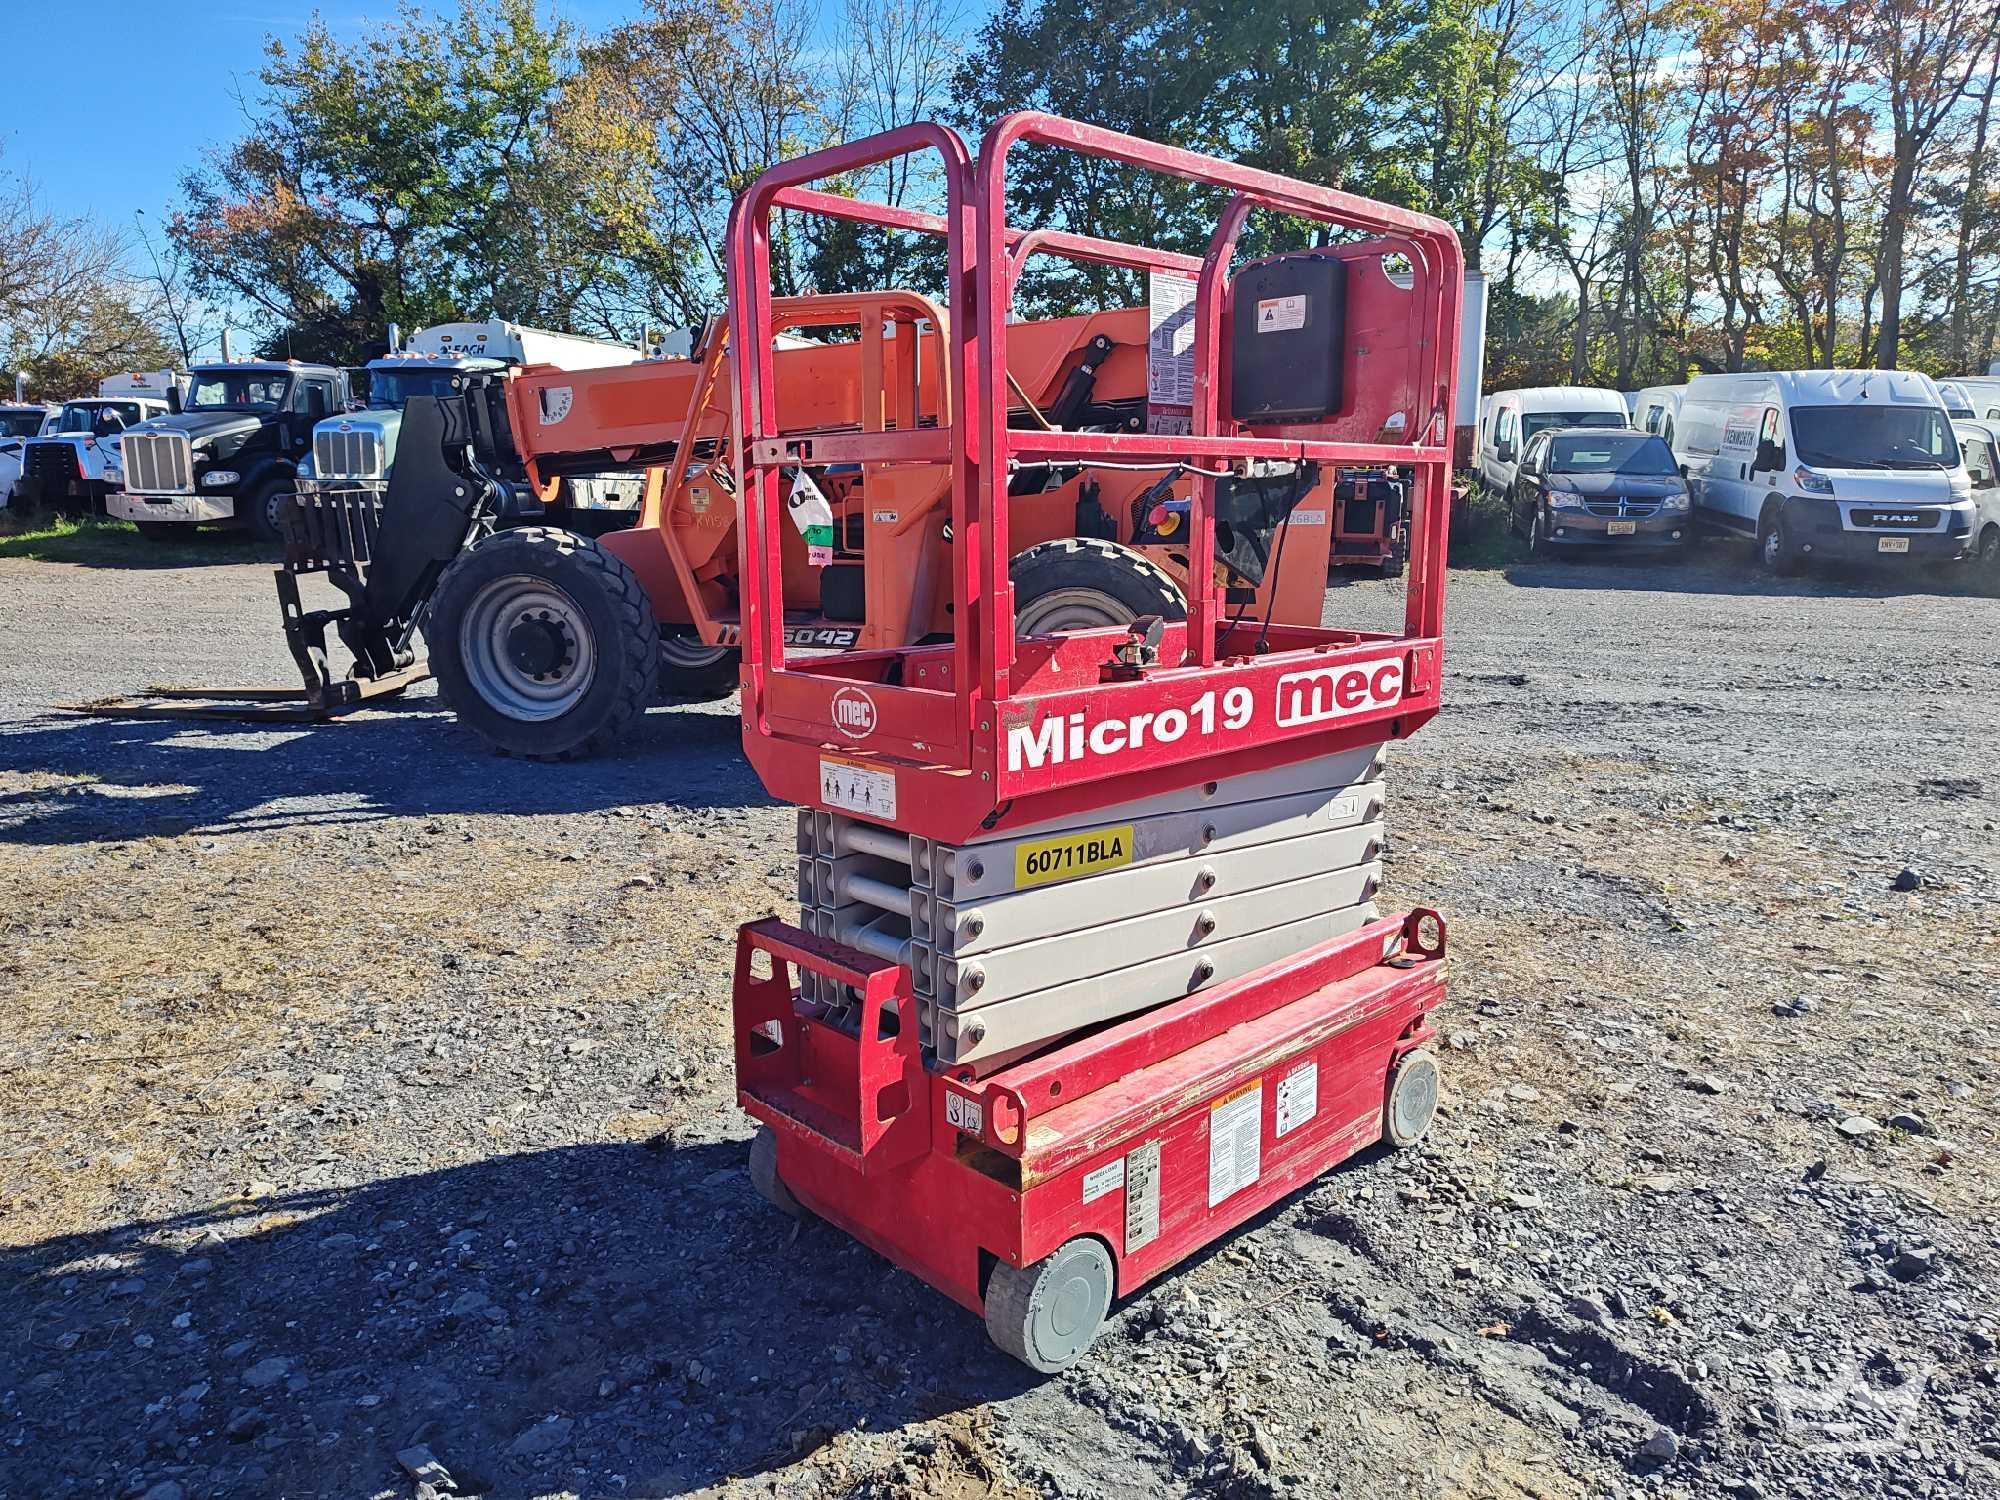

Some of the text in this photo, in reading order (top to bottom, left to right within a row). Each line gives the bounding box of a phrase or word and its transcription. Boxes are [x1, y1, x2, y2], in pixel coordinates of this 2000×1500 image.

[837, 699, 871, 728] mec
[1008, 664, 1401, 772] Micro19 mec
[1026, 837, 1123, 875] 60711BLA
